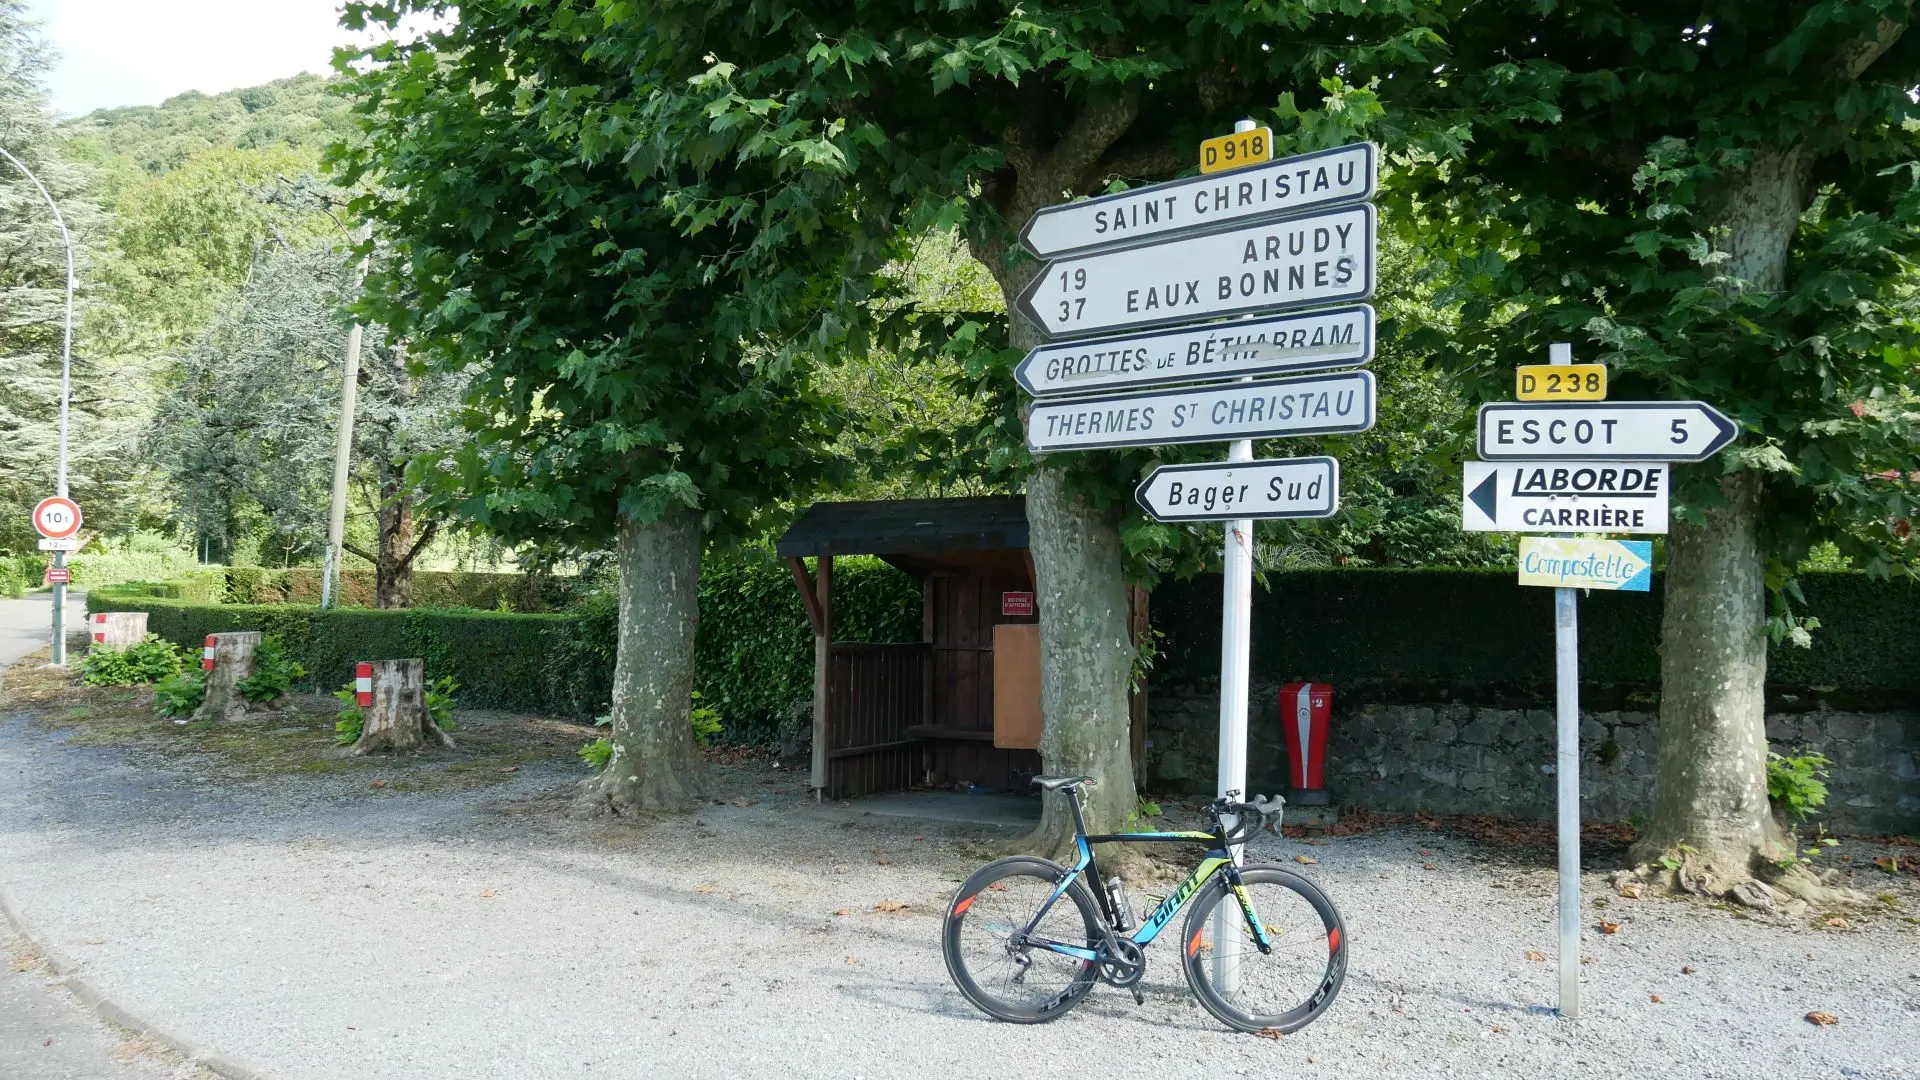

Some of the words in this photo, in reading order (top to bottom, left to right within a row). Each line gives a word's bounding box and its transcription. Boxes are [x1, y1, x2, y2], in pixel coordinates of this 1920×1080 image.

[1205, 146, 1217, 167] D
[1224, 135, 1264, 161] 918
[1094, 196, 1177, 234] SAINT
[1194, 160, 1355, 214] CHRISTAU
[1059, 268, 1087, 293] 19
[1242, 222, 1354, 264] ARUDY
[1058, 297, 1087, 323] 37
[1127, 280, 1200, 313] EAUX
[1218, 257, 1353, 300] BONNES
[1046, 347, 1148, 382] GROTTES
[1521, 374, 1537, 394] D
[1546, 373, 1600, 394] 238
[1046, 406, 1156, 437] THERMES
[1211, 389, 1355, 425] CHRISTAU
[1497, 419, 1618, 444] ESCOT
[1670, 418, 1689, 444] 5
[1168, 481, 1249, 511] Bager
[1266, 474, 1323, 502] Sud
[1511, 468, 1663, 498] LABORDE
[1522, 503, 1645, 528] CARRIÈRE
[1525, 551, 1634, 583] Compostelle
[1153, 870, 1199, 929] GIANT
